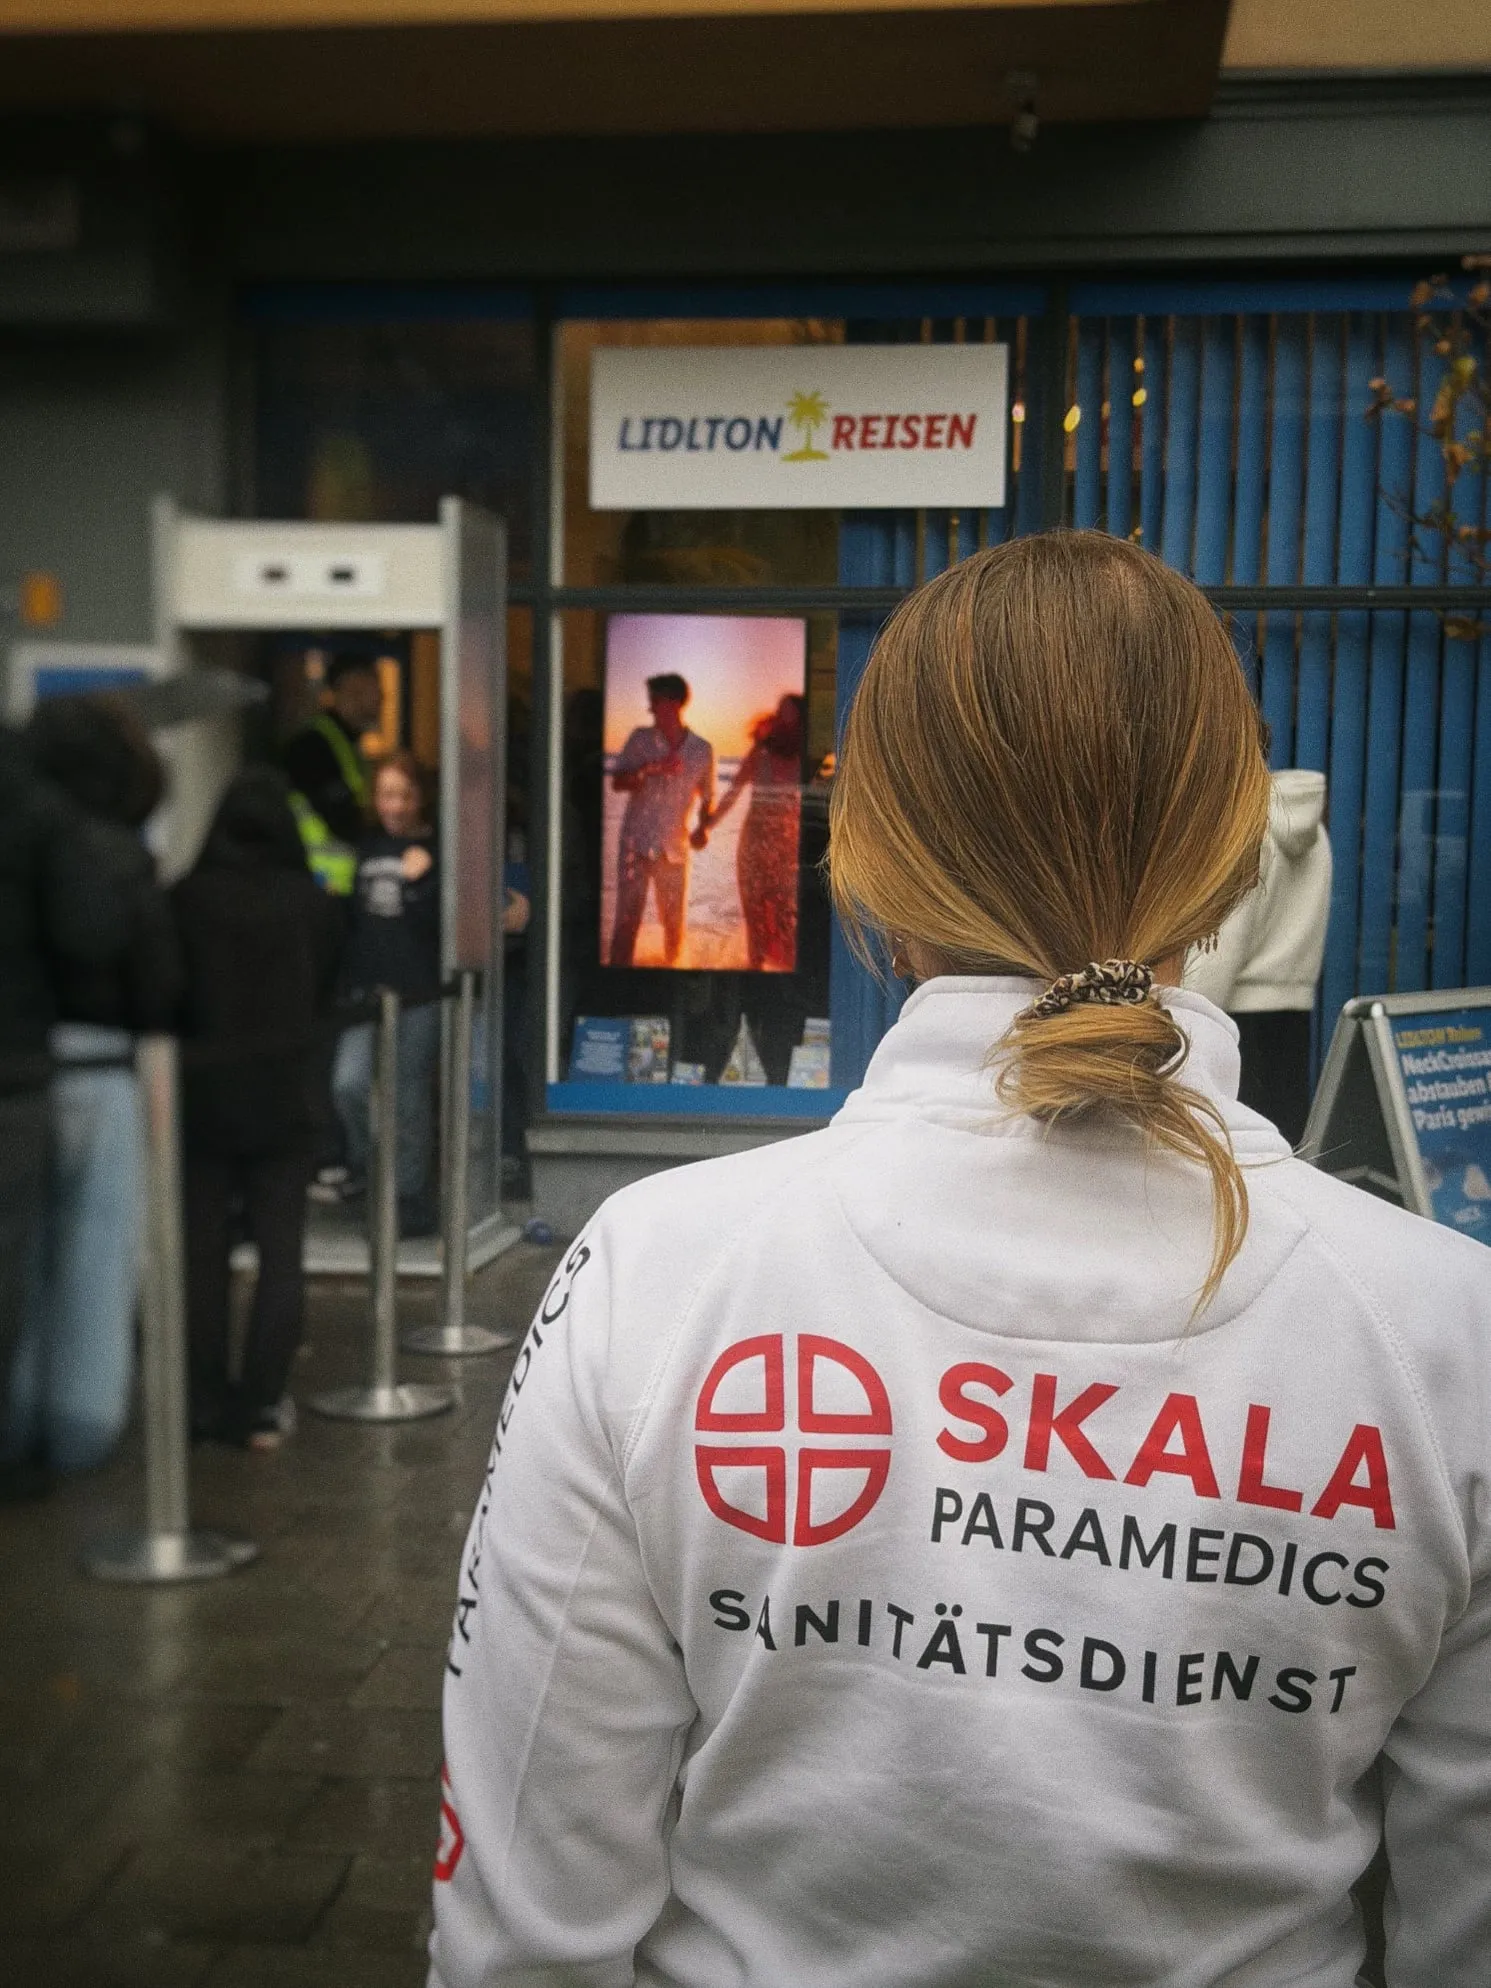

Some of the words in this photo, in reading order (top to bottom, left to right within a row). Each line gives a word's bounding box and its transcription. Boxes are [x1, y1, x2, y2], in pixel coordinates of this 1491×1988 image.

[618, 416, 784, 452] LIDLTON
[831, 413, 977, 450] REISEN
[935, 1361, 1397, 1530] SKALA
[930, 1486, 1390, 1608] PARAMEDICS
[708, 1588, 1357, 1714] SANITÄTSDIENST
